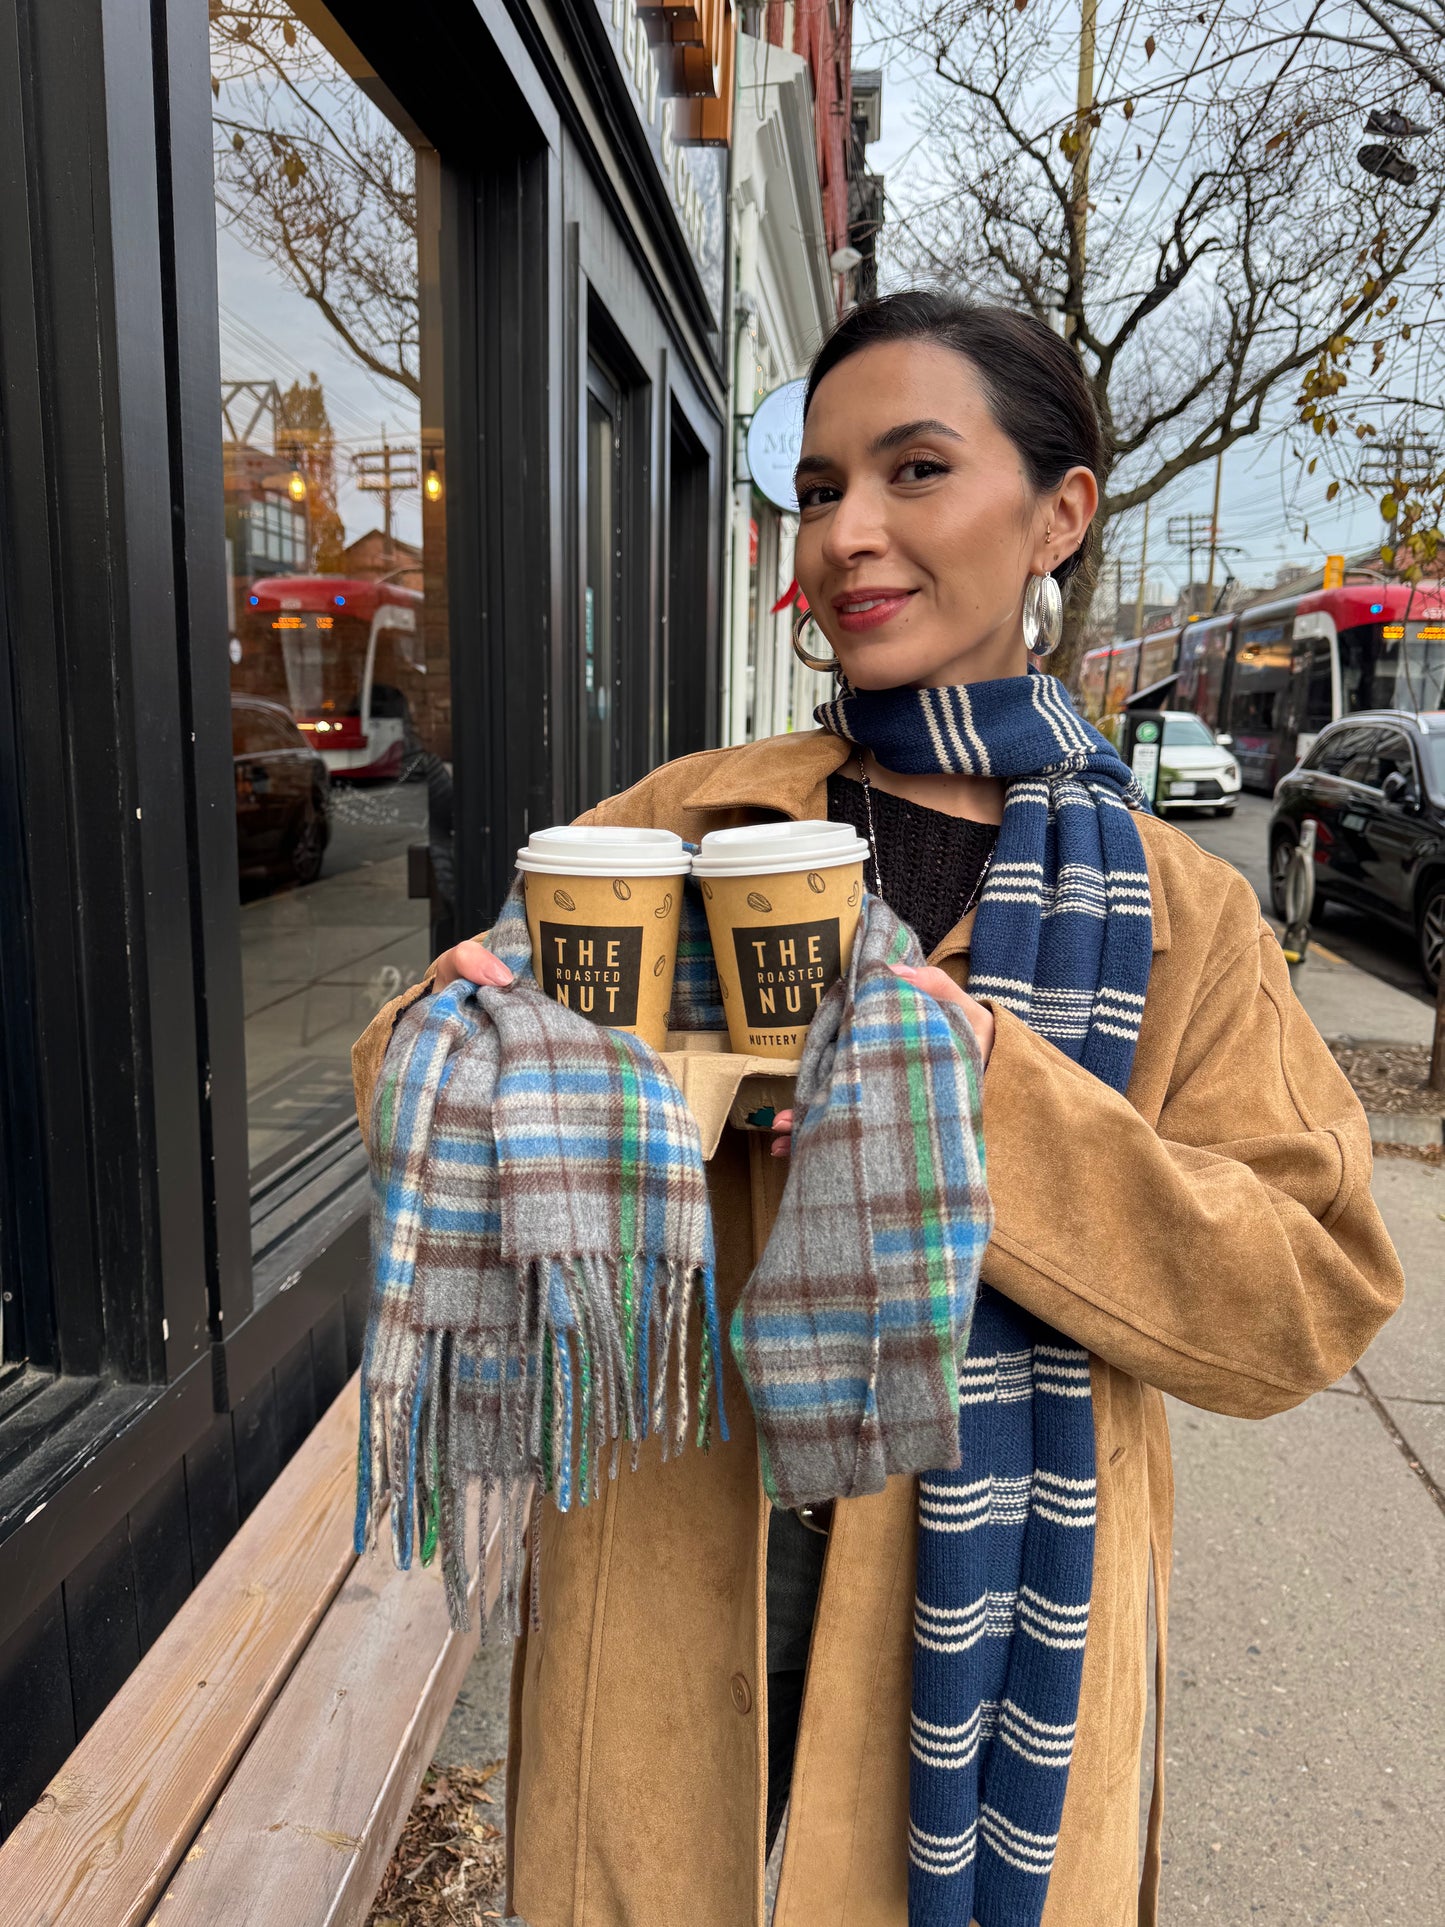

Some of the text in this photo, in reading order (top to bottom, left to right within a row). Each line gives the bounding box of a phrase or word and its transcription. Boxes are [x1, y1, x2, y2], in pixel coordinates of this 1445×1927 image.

[554, 937, 621, 968] THE
[751, 935, 822, 968] THE
[556, 968, 621, 983] ROASTED
[757, 966, 824, 984] ROASTED
[556, 983, 620, 1013] NUT
[759, 982, 825, 1014] NUT
[749, 1033, 797, 1046] NUTTERY
